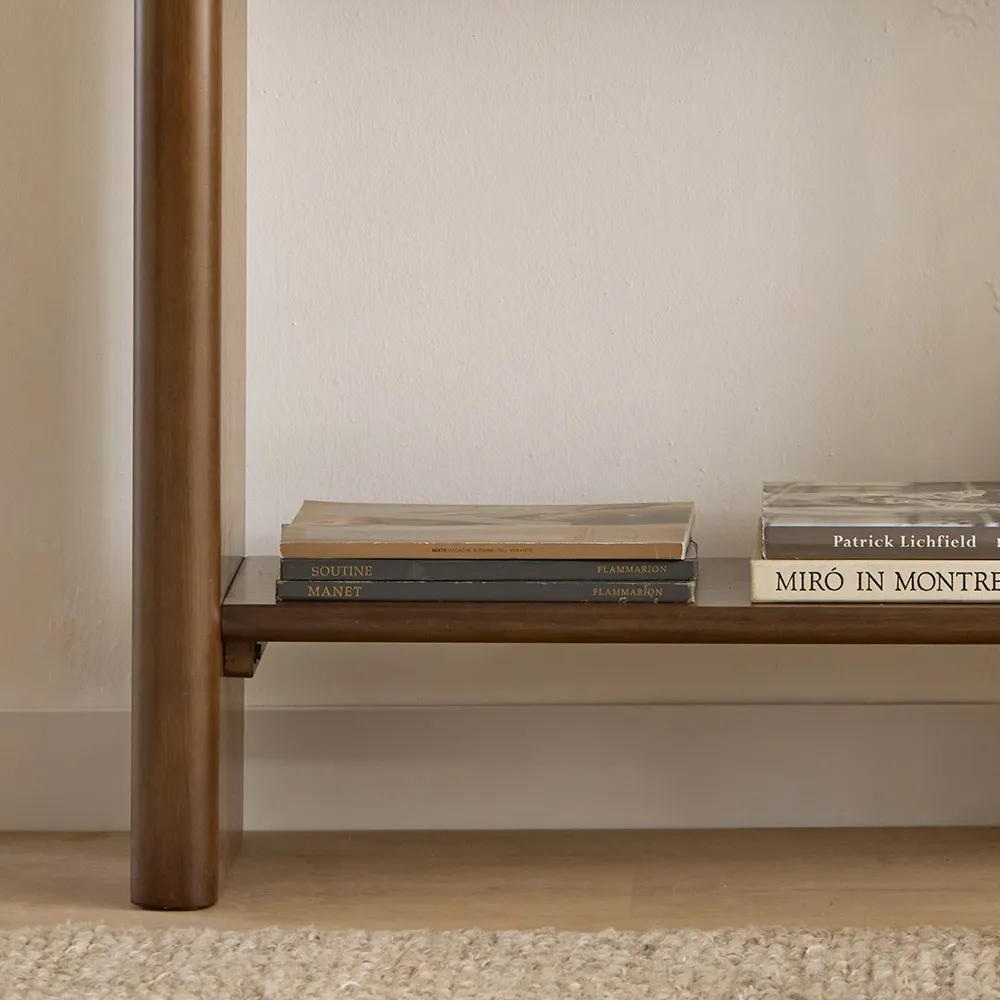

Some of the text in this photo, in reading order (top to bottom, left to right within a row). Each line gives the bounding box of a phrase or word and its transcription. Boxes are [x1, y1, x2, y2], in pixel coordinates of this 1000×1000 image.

[833, 535, 894, 548] Patrick
[900, 535, 977, 548] Lichfield
[311, 565, 667, 577] SOUTINE FLAMMARION
[775, 567, 844, 592] MIRÓ
[856, 571, 884, 591] IN
[307, 585, 663, 597] MANET FLAMMARION
